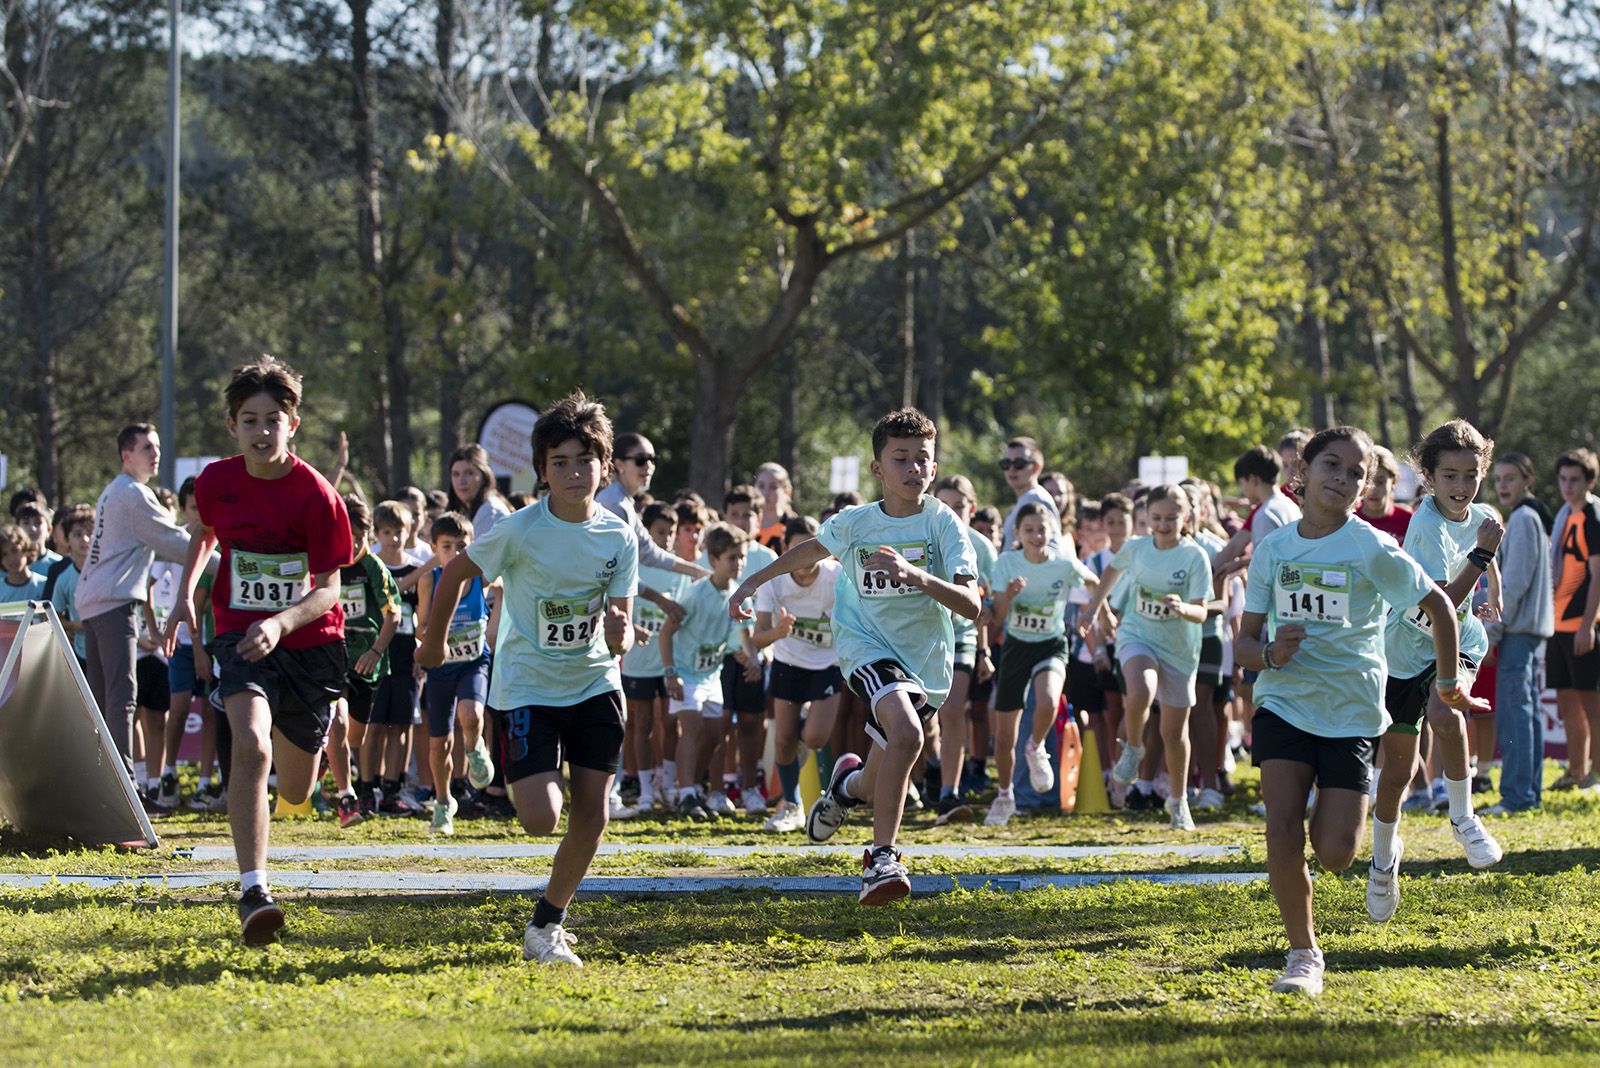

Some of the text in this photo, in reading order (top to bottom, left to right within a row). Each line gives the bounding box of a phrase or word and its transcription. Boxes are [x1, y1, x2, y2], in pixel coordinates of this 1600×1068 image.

[1281, 570, 1300, 584] CROS
[241, 580, 293, 601] 2037
[1142, 601, 1169, 616] 1124
[1290, 592, 1324, 614] 141
[545, 605, 570, 617] CROS
[450, 641, 479, 657] 1537
